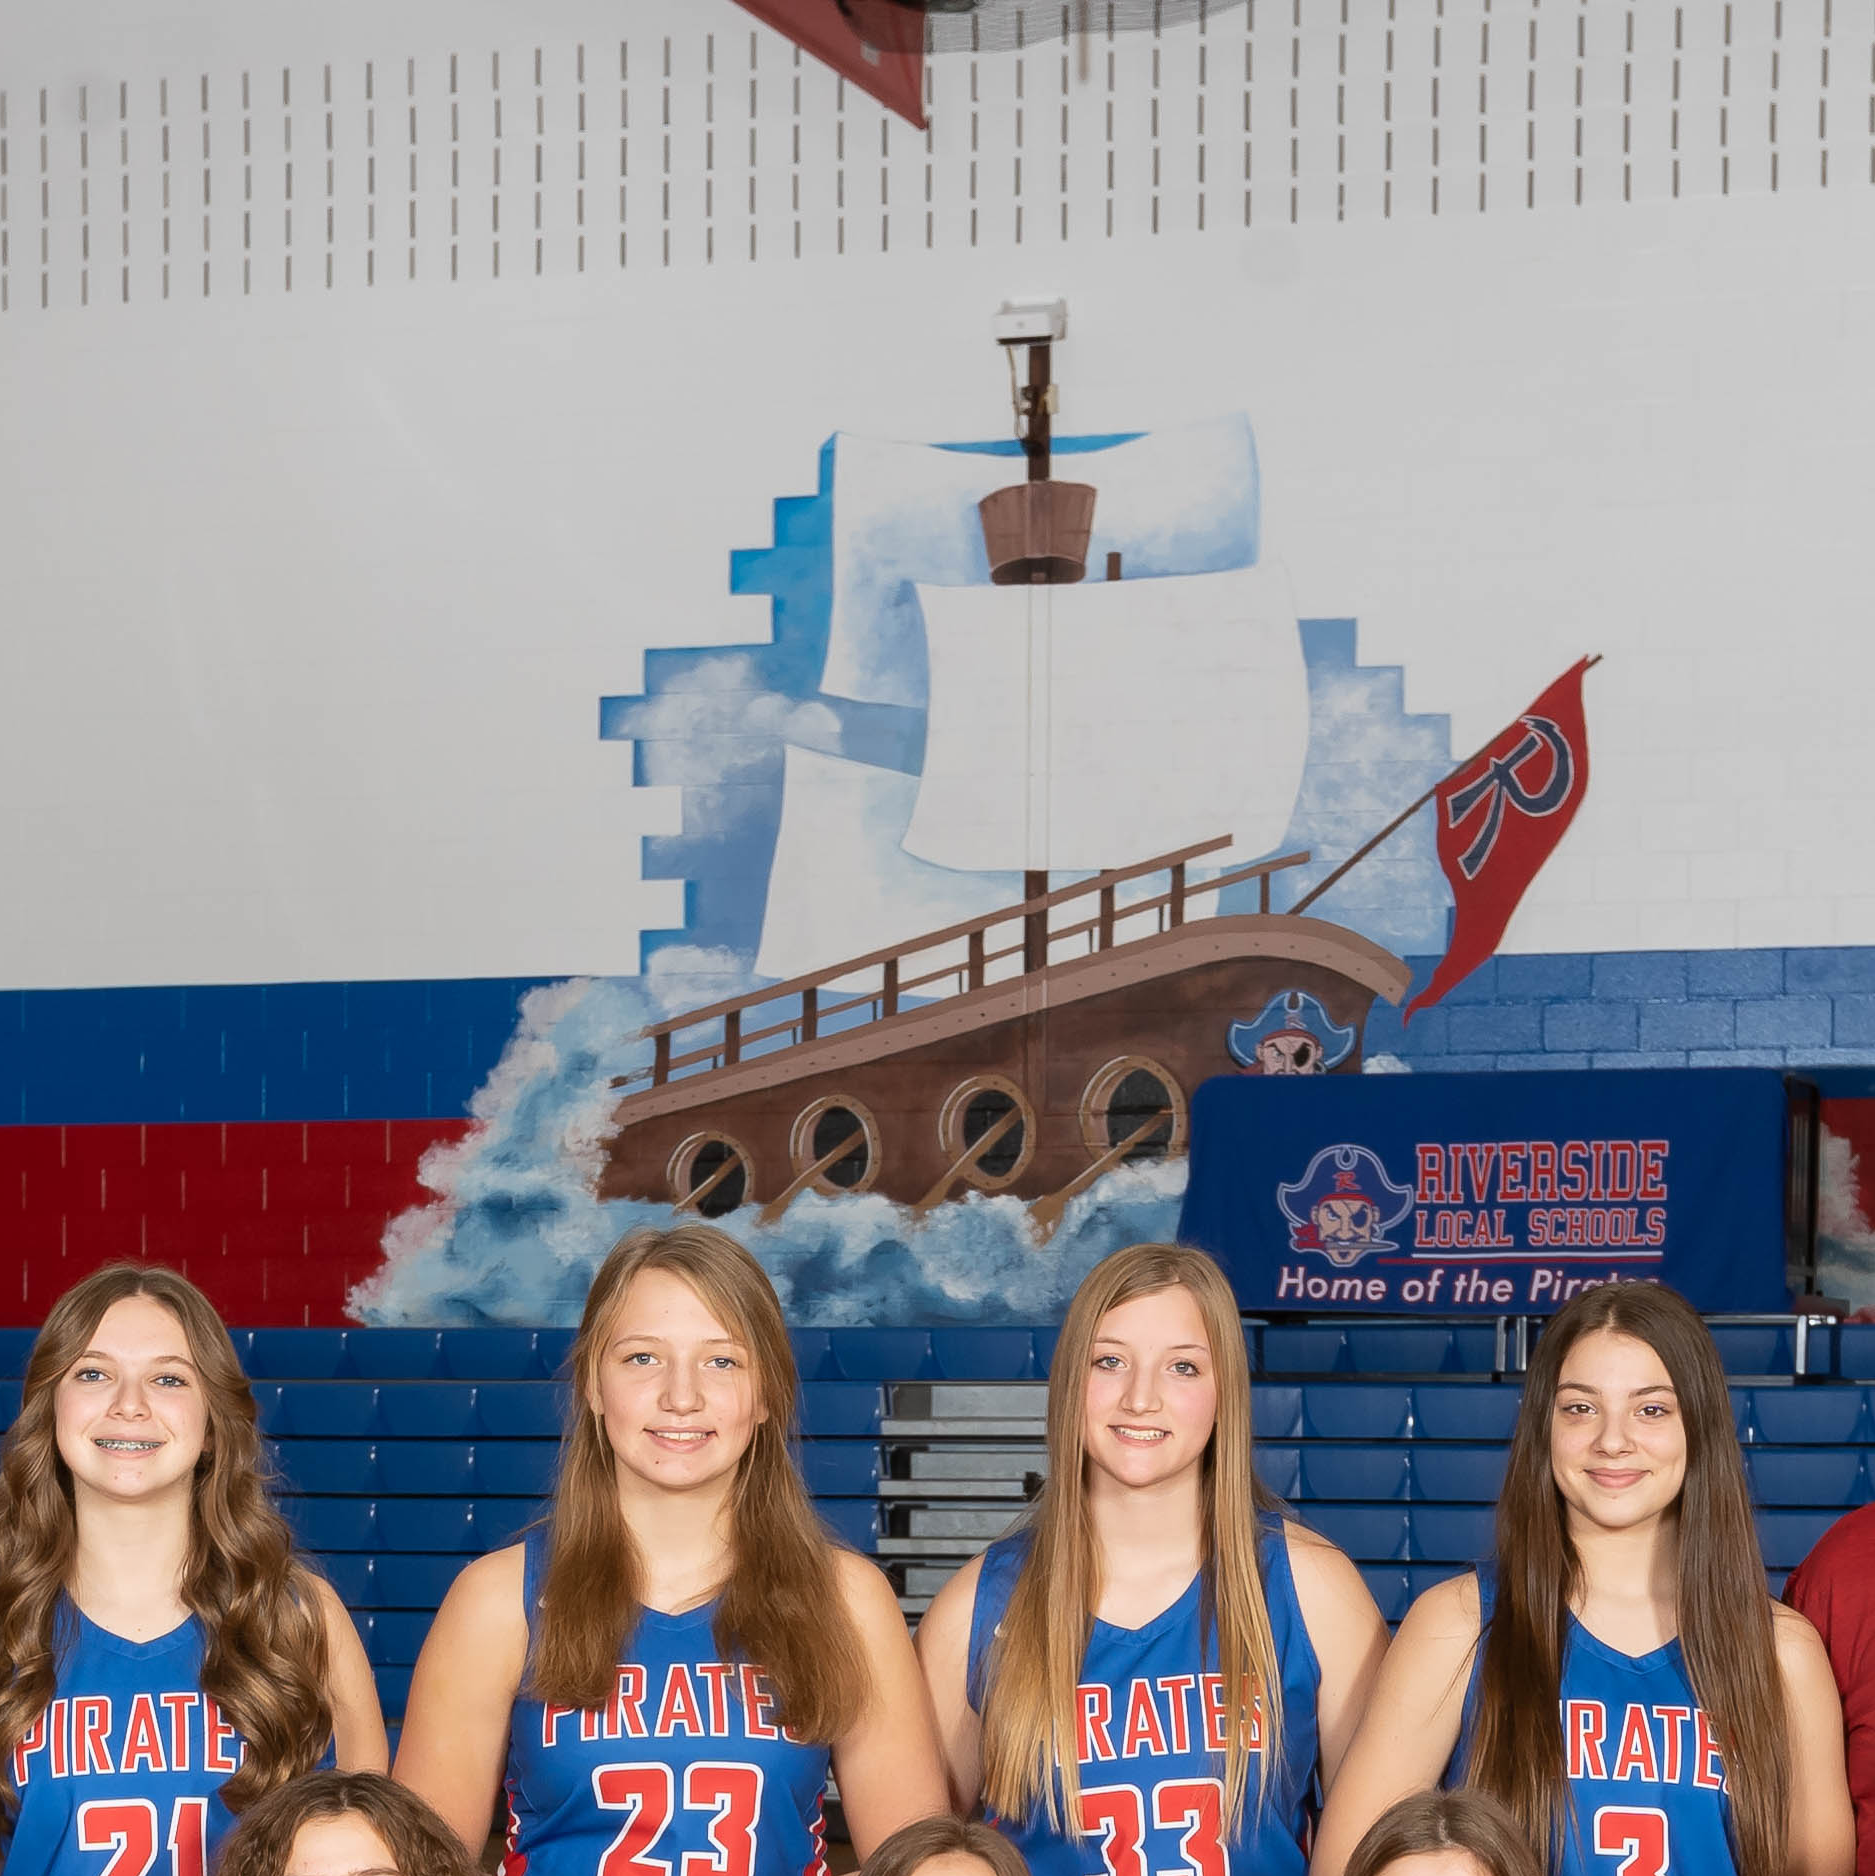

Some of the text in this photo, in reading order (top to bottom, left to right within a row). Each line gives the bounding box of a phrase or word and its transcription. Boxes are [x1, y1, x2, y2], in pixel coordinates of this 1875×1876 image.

[1415, 1139, 1670, 1204] RIVERSIDE
[1414, 1207, 1667, 1248] LOCAL SCHOOLS
[1277, 1266, 1387, 1301] Home
[1402, 1268, 1445, 1303] of
[1453, 1268, 1514, 1303] the
[13, 1691, 249, 1787] PIRATE
[1559, 1699, 1732, 1796] RATE
